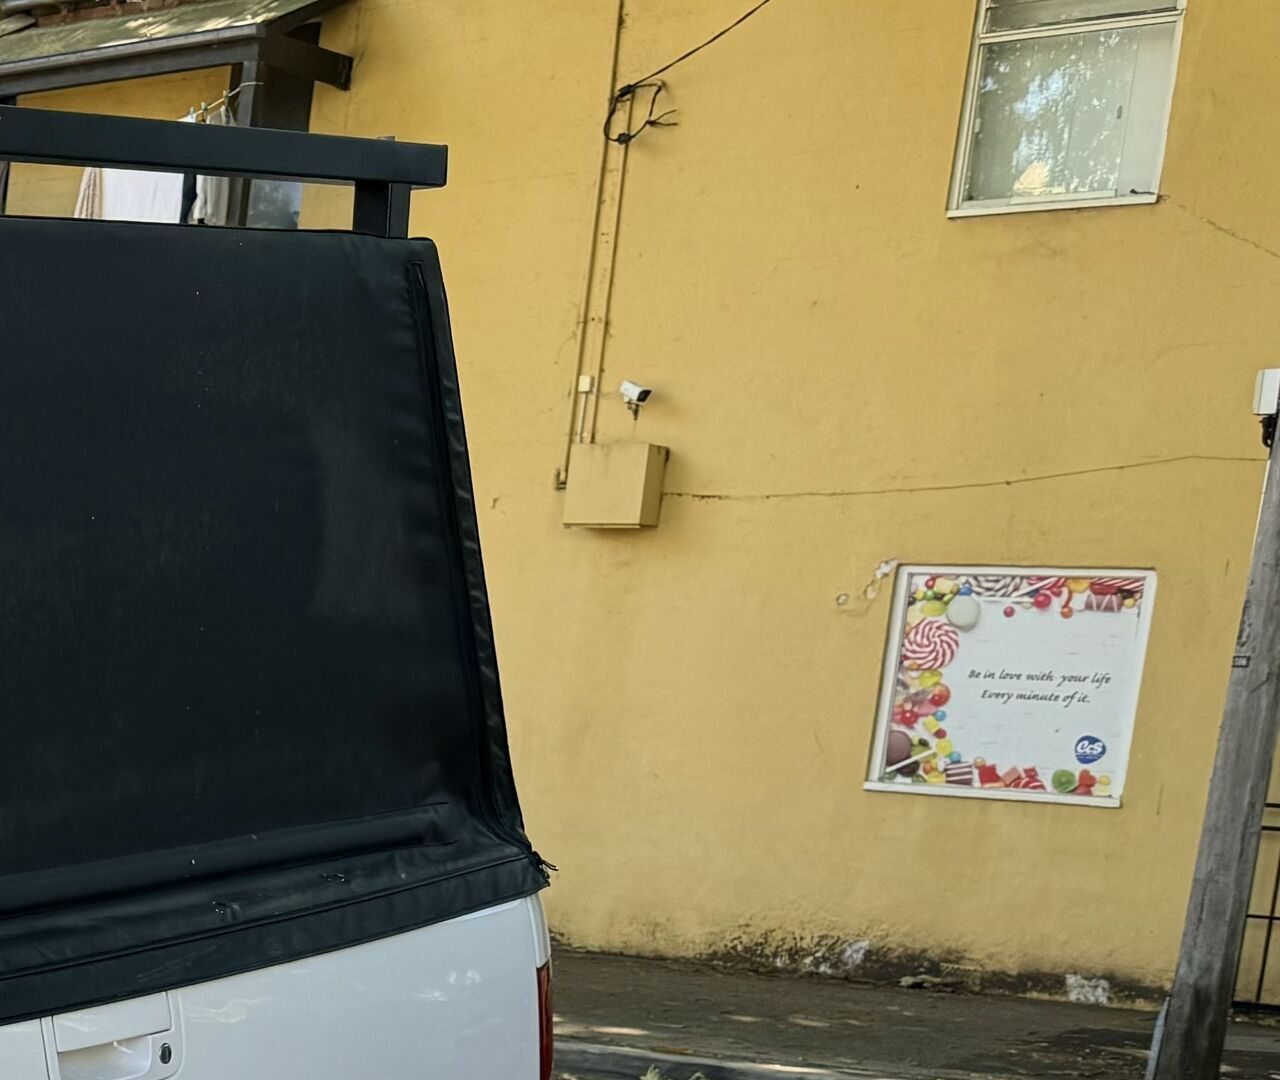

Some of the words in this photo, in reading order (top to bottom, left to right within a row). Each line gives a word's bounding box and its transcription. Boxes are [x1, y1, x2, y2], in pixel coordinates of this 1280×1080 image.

[968, 669, 982, 679] Be
[983, 669, 996, 680] in
[998, 669, 1021, 681] love
[1026, 670, 1053, 682] with
[1057, 674, 1089, 687] your
[1091, 672, 1112, 689] life
[981, 689, 1014, 705] Every
[1016, 690, 1059, 702] minute
[1062, 691, 1078, 708] of
